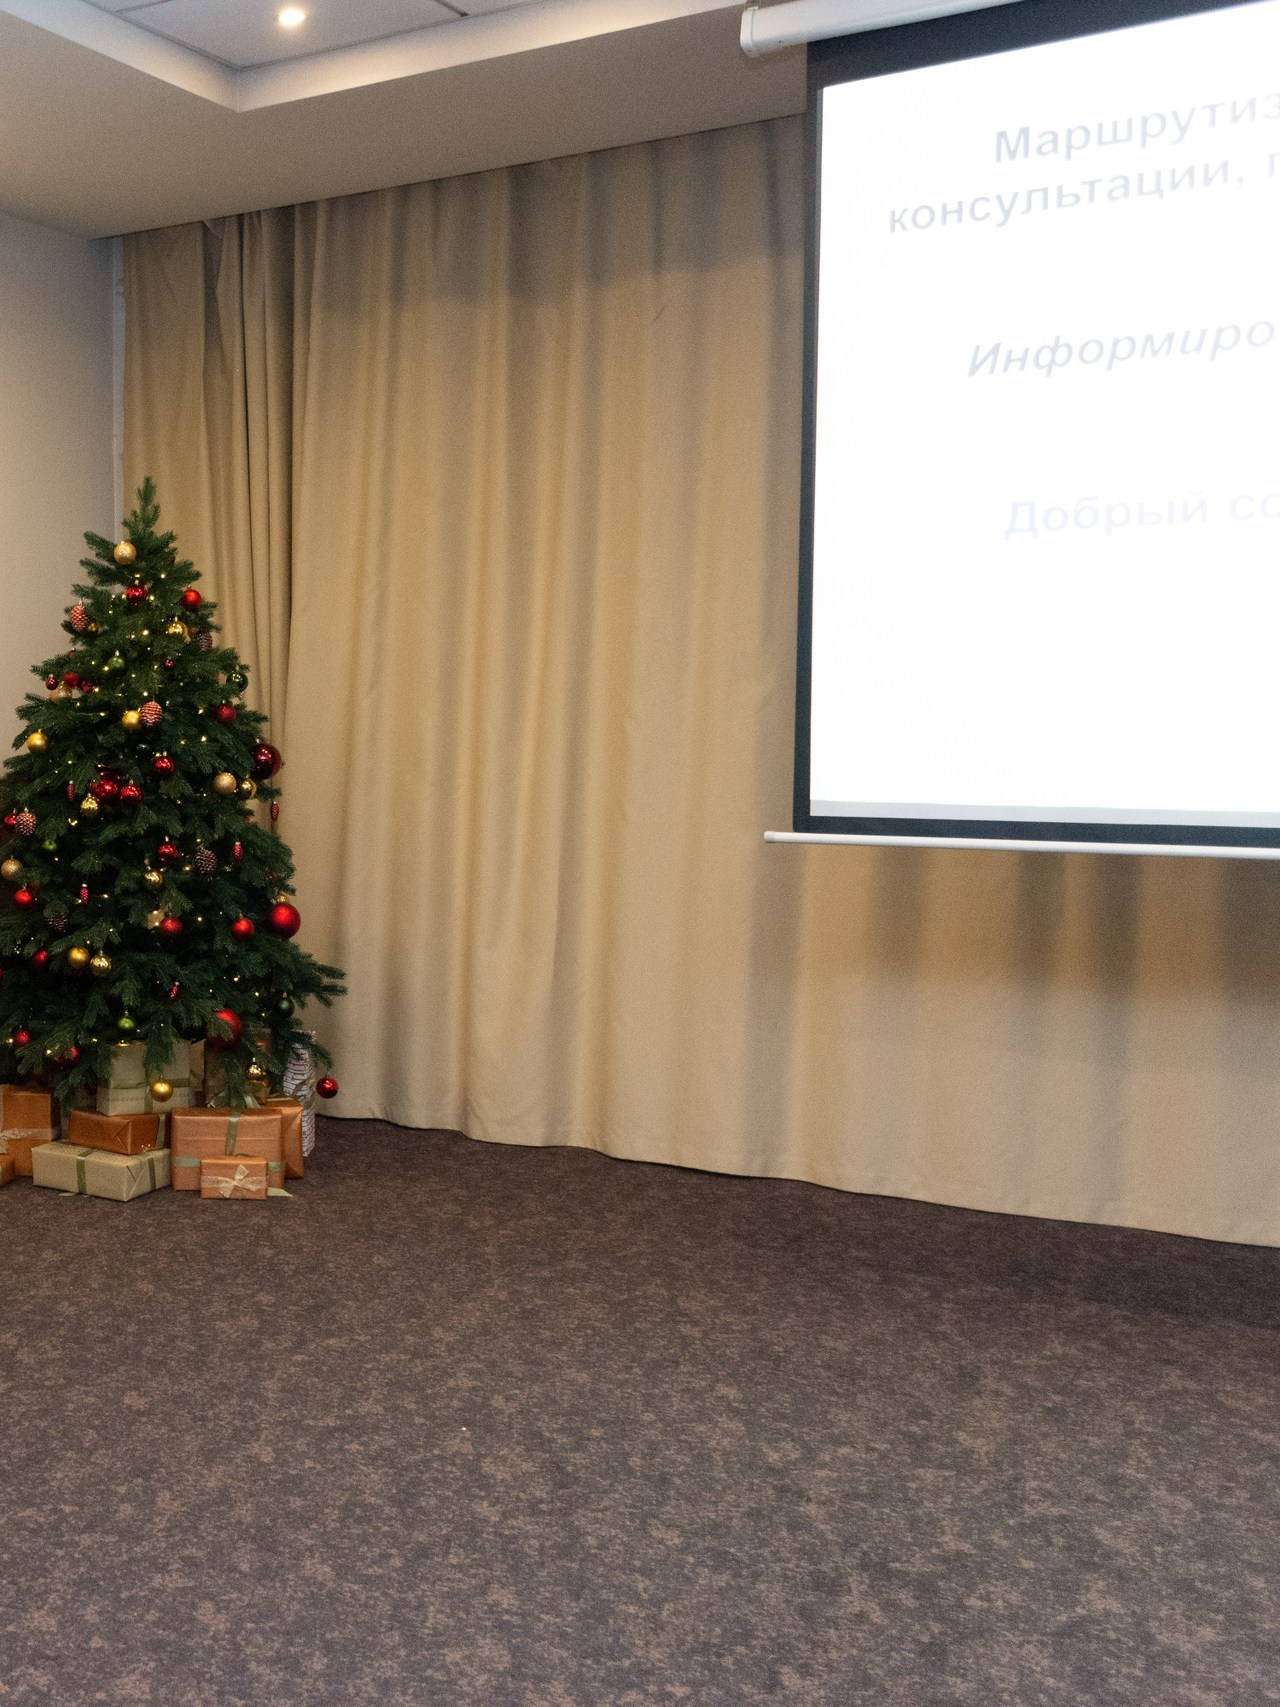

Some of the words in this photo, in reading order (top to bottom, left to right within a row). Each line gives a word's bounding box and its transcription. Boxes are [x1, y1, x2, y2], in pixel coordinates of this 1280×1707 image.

[888, 159, 1244, 234] консультации,
[967, 320, 1276, 378] Информиро
[1004, 490, 1208, 541] Добрый
